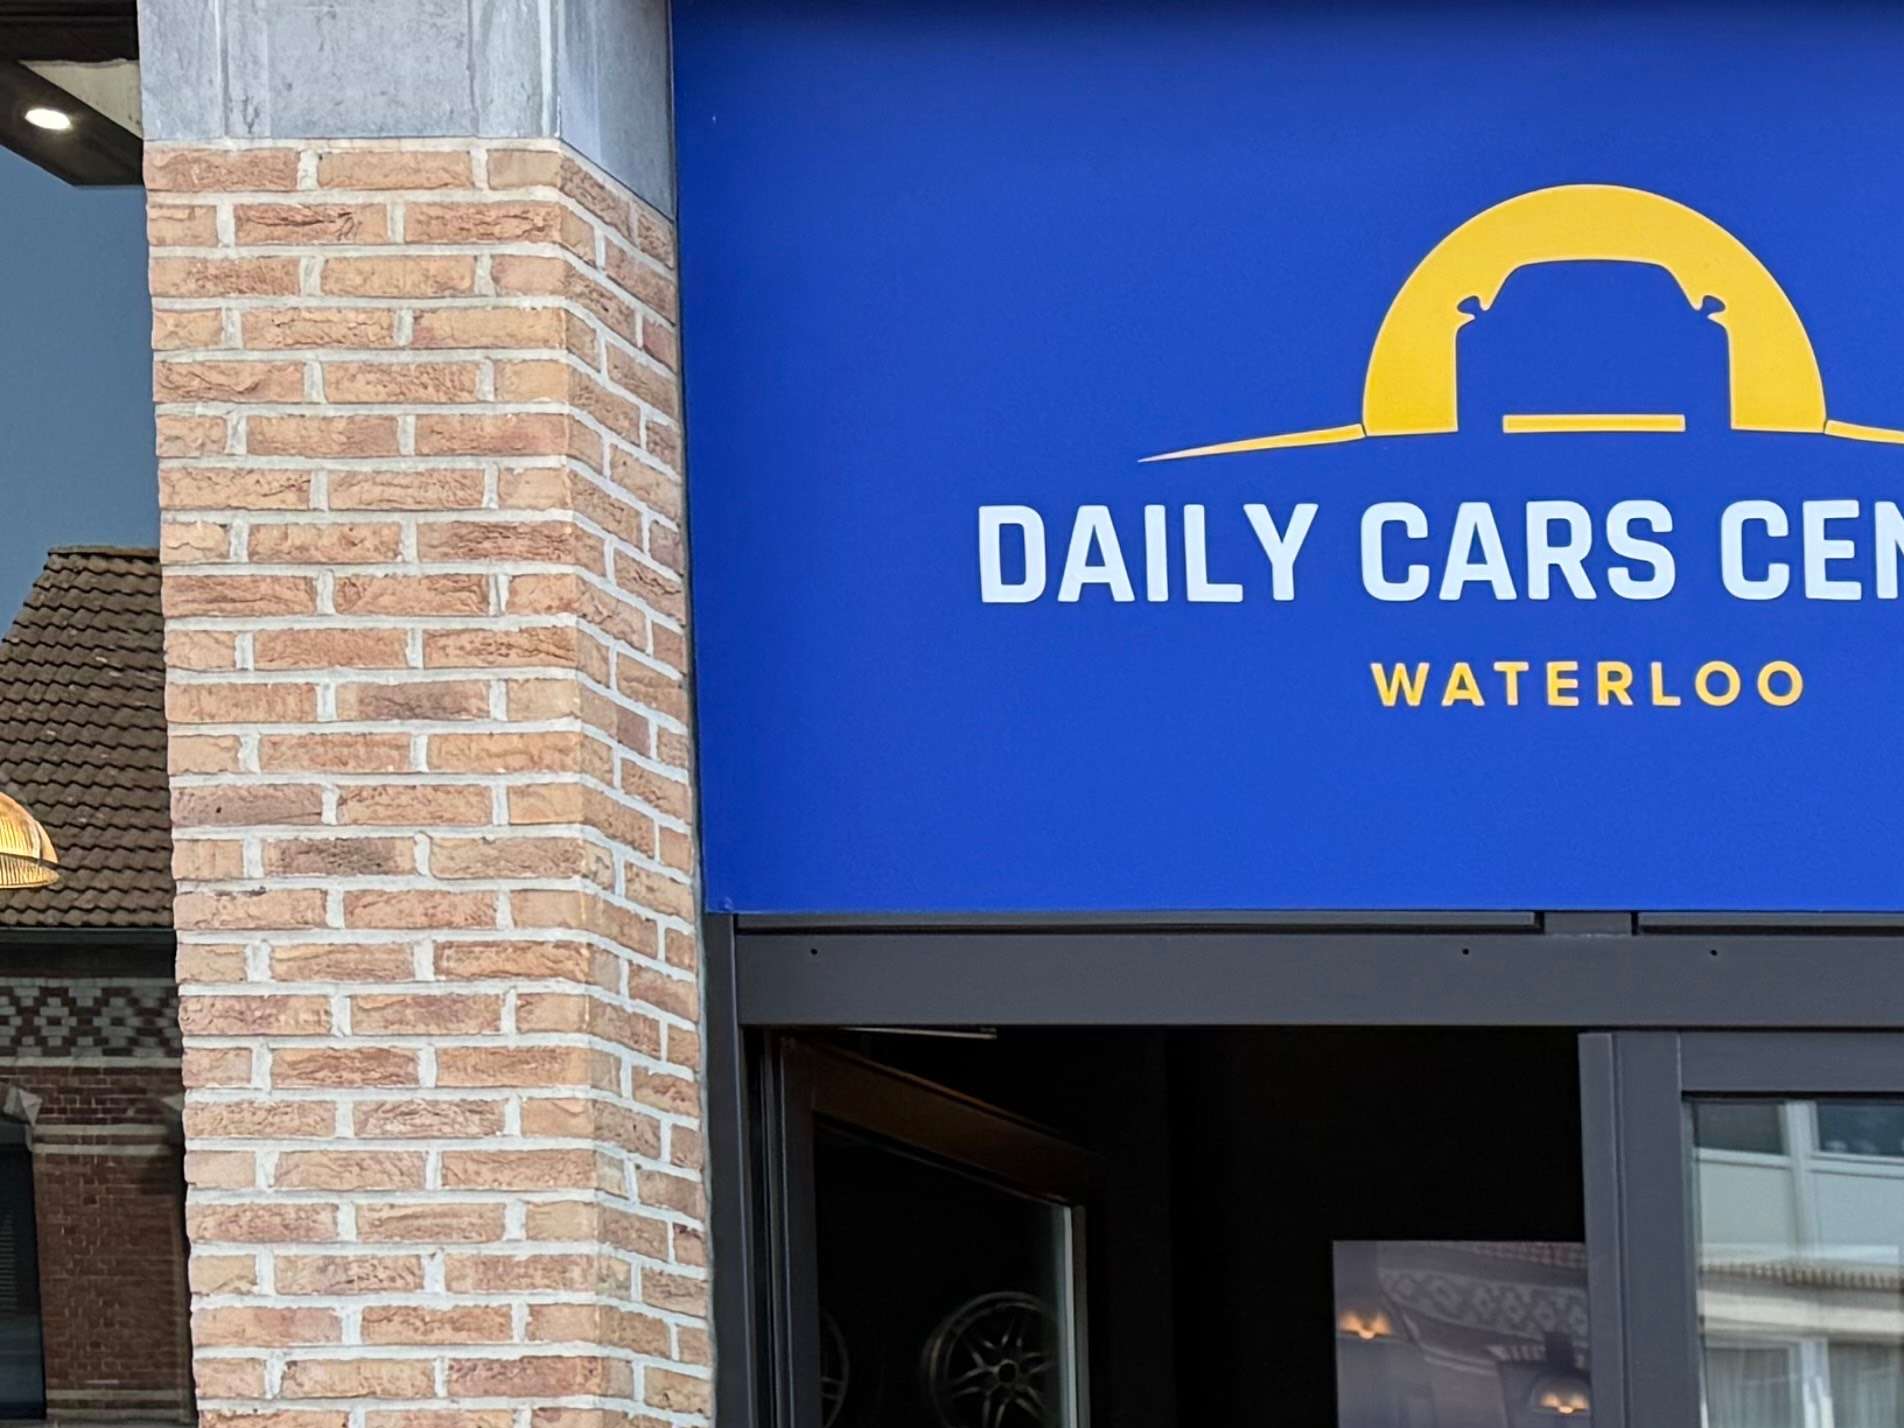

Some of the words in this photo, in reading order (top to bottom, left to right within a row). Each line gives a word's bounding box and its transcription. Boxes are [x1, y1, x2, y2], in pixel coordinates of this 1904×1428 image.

[978, 503, 1319, 603] DAILY
[1360, 499, 1676, 602] CARS
[1370, 660, 1805, 707] WATERLOO
